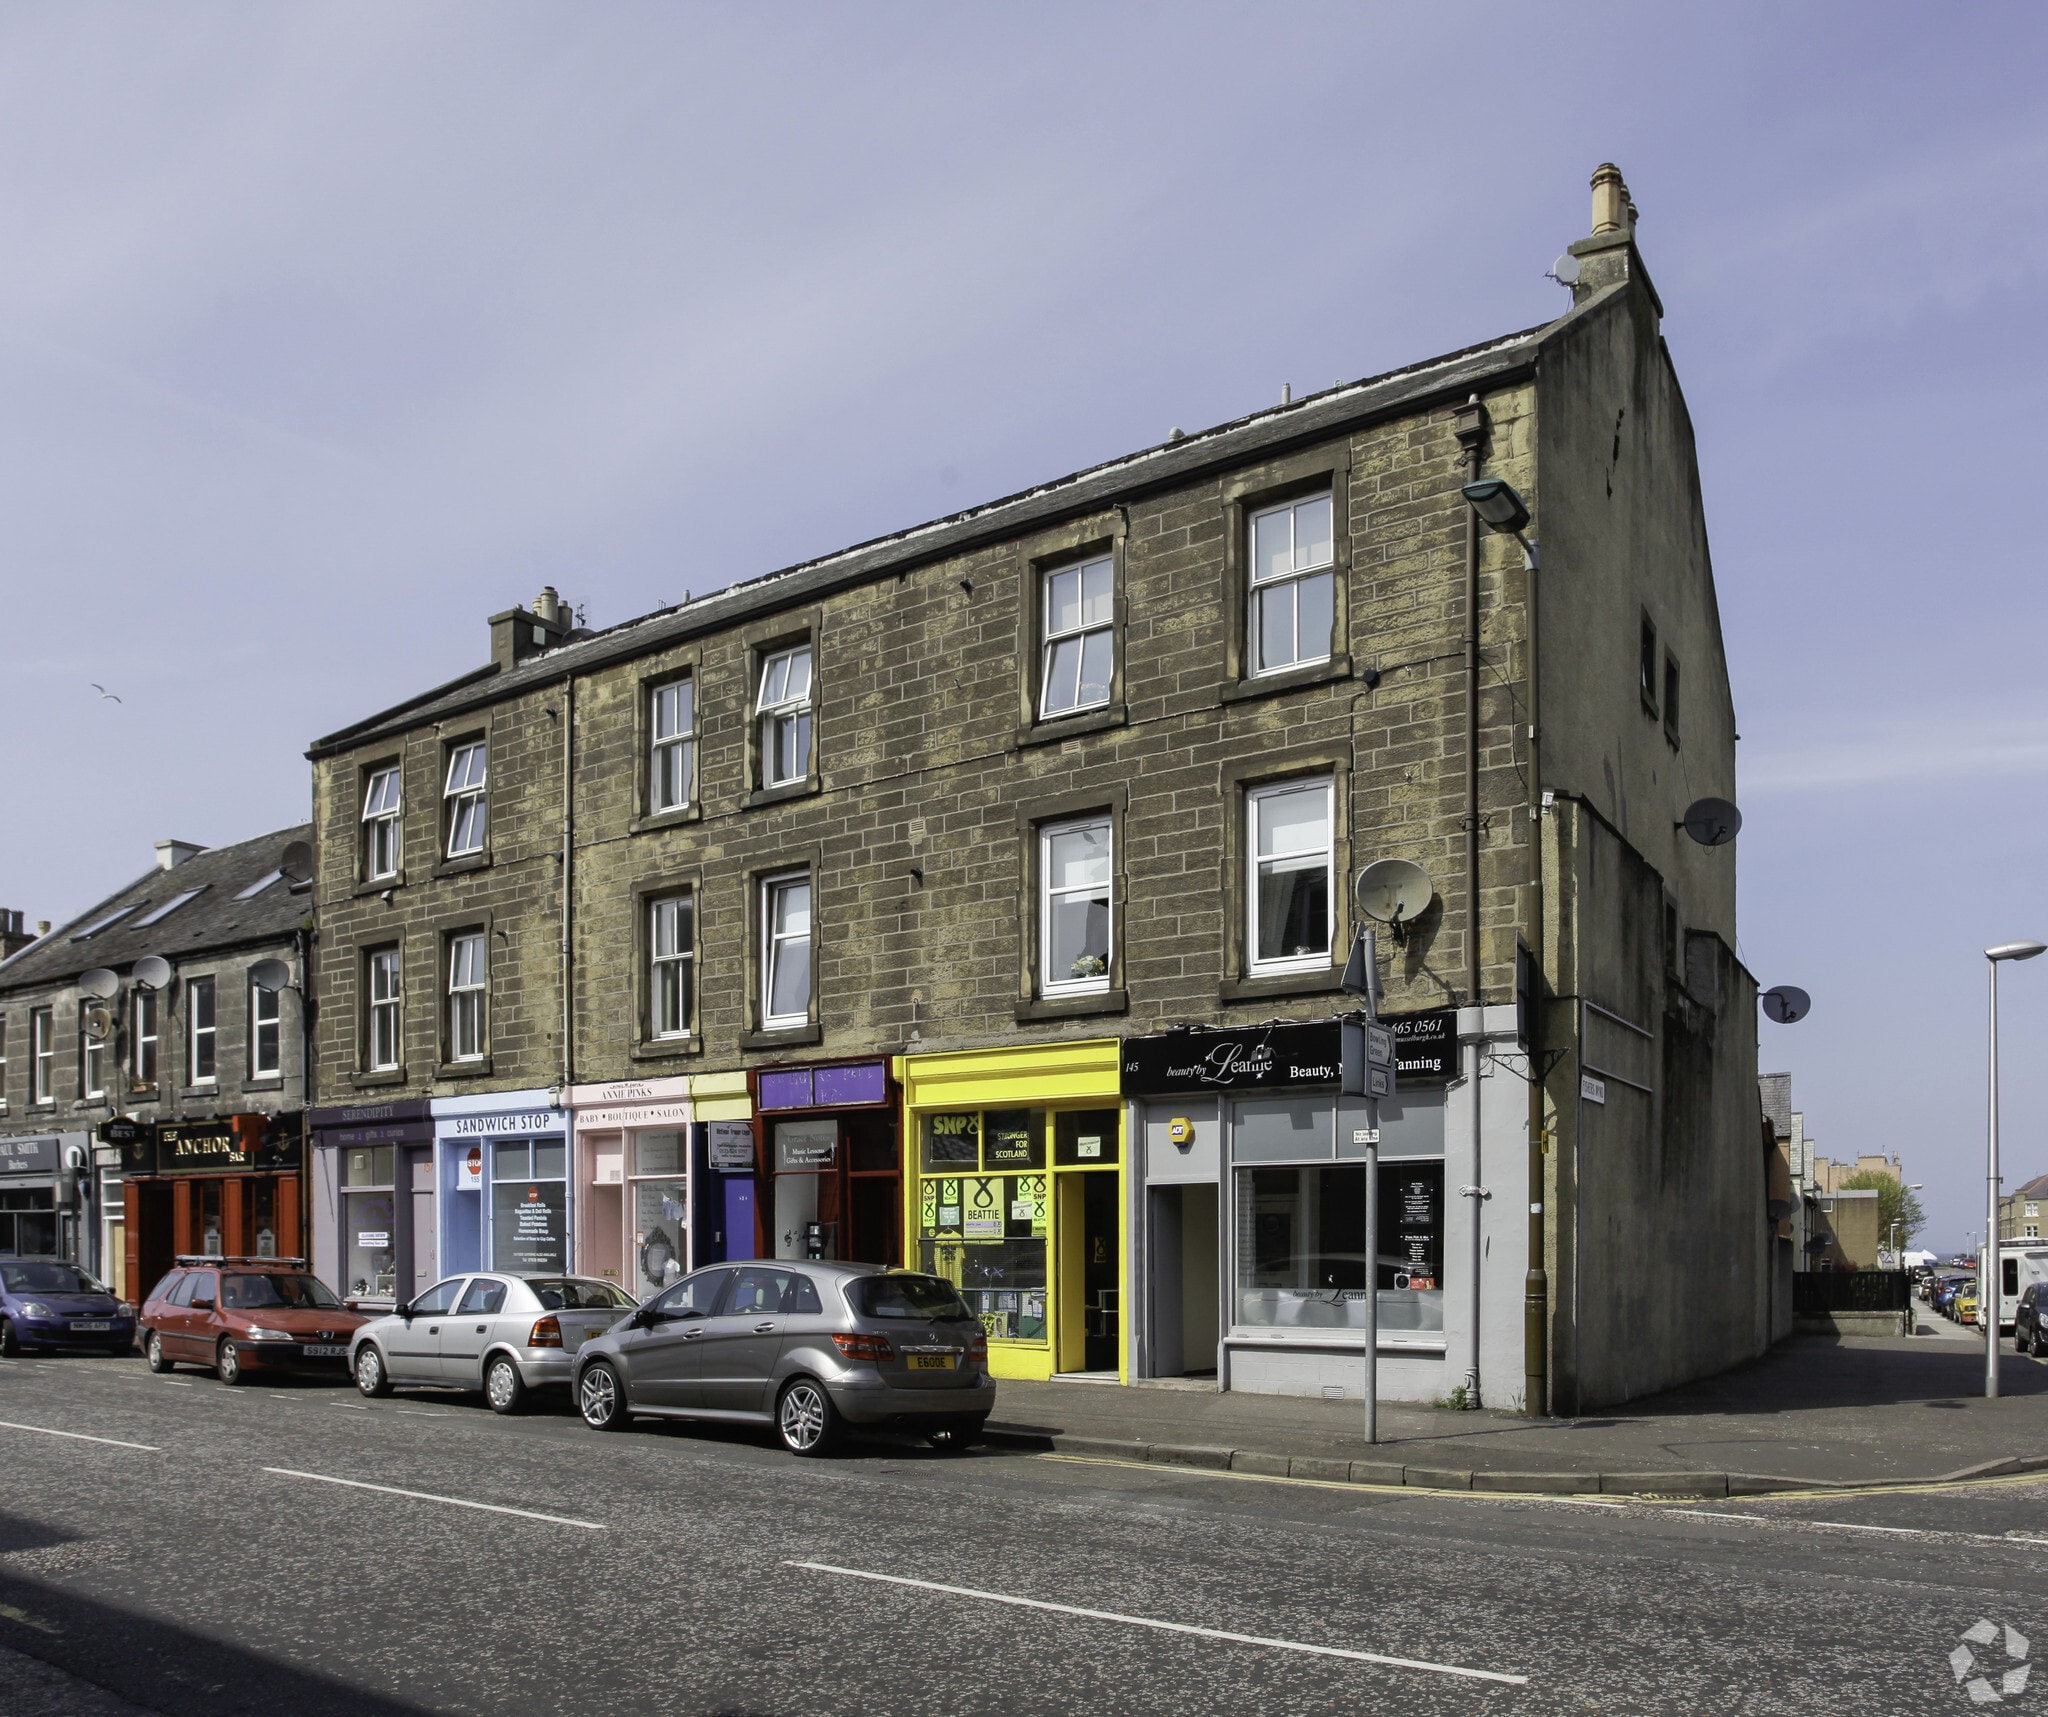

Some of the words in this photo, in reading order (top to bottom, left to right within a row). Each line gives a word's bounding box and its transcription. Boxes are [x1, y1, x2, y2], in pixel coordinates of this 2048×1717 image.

[1414, 1019, 1443, 1033] 0561
[1370, 1032, 1387, 1048] Bowling
[1369, 1045, 1383, 1057] Green
[1125, 1062, 1139, 1073] 145
[1200, 1042, 1273, 1084] Leanne
[1166, 1065, 1195, 1078] beauty
[1195, 1064, 1207, 1076] by
[1290, 1065, 1334, 1079] Beauty,
[1373, 1076, 1385, 1089] Links
[602, 1090, 626, 1100] ANNIE
[628, 1087, 652, 1098] PINKS
[342, 1105, 395, 1120] SERENDIPITY
[579, 1114, 599, 1124] BABY
[607, 1111, 649, 1122] BOUTIQUE
[657, 1108, 685, 1118] SALON
[456, 1117, 516, 1134] SANDWICH
[521, 1114, 550, 1130] STOP
[933, 1116, 967, 1135] SNP
[1172, 1125, 1183, 1135] ADT
[110, 1129, 136, 1138] BEST
[997, 1131, 1028, 1140] STRONGER
[0, 1144, 14, 1156] AUL
[17, 1142, 39, 1154] SMITH
[175, 1136, 231, 1155] ANCHOR
[1015, 1140, 1028, 1148] FOR
[995, 1149, 1028, 1159] SCOTLAND
[968, 1209, 1000, 1220] BEATTIE
[1293, 1290, 1314, 1298] beauty
[1314, 1290, 1323, 1298] by
[1320, 1288, 1367, 1307] Leann
[917, 1357, 946, 1368] E600E
